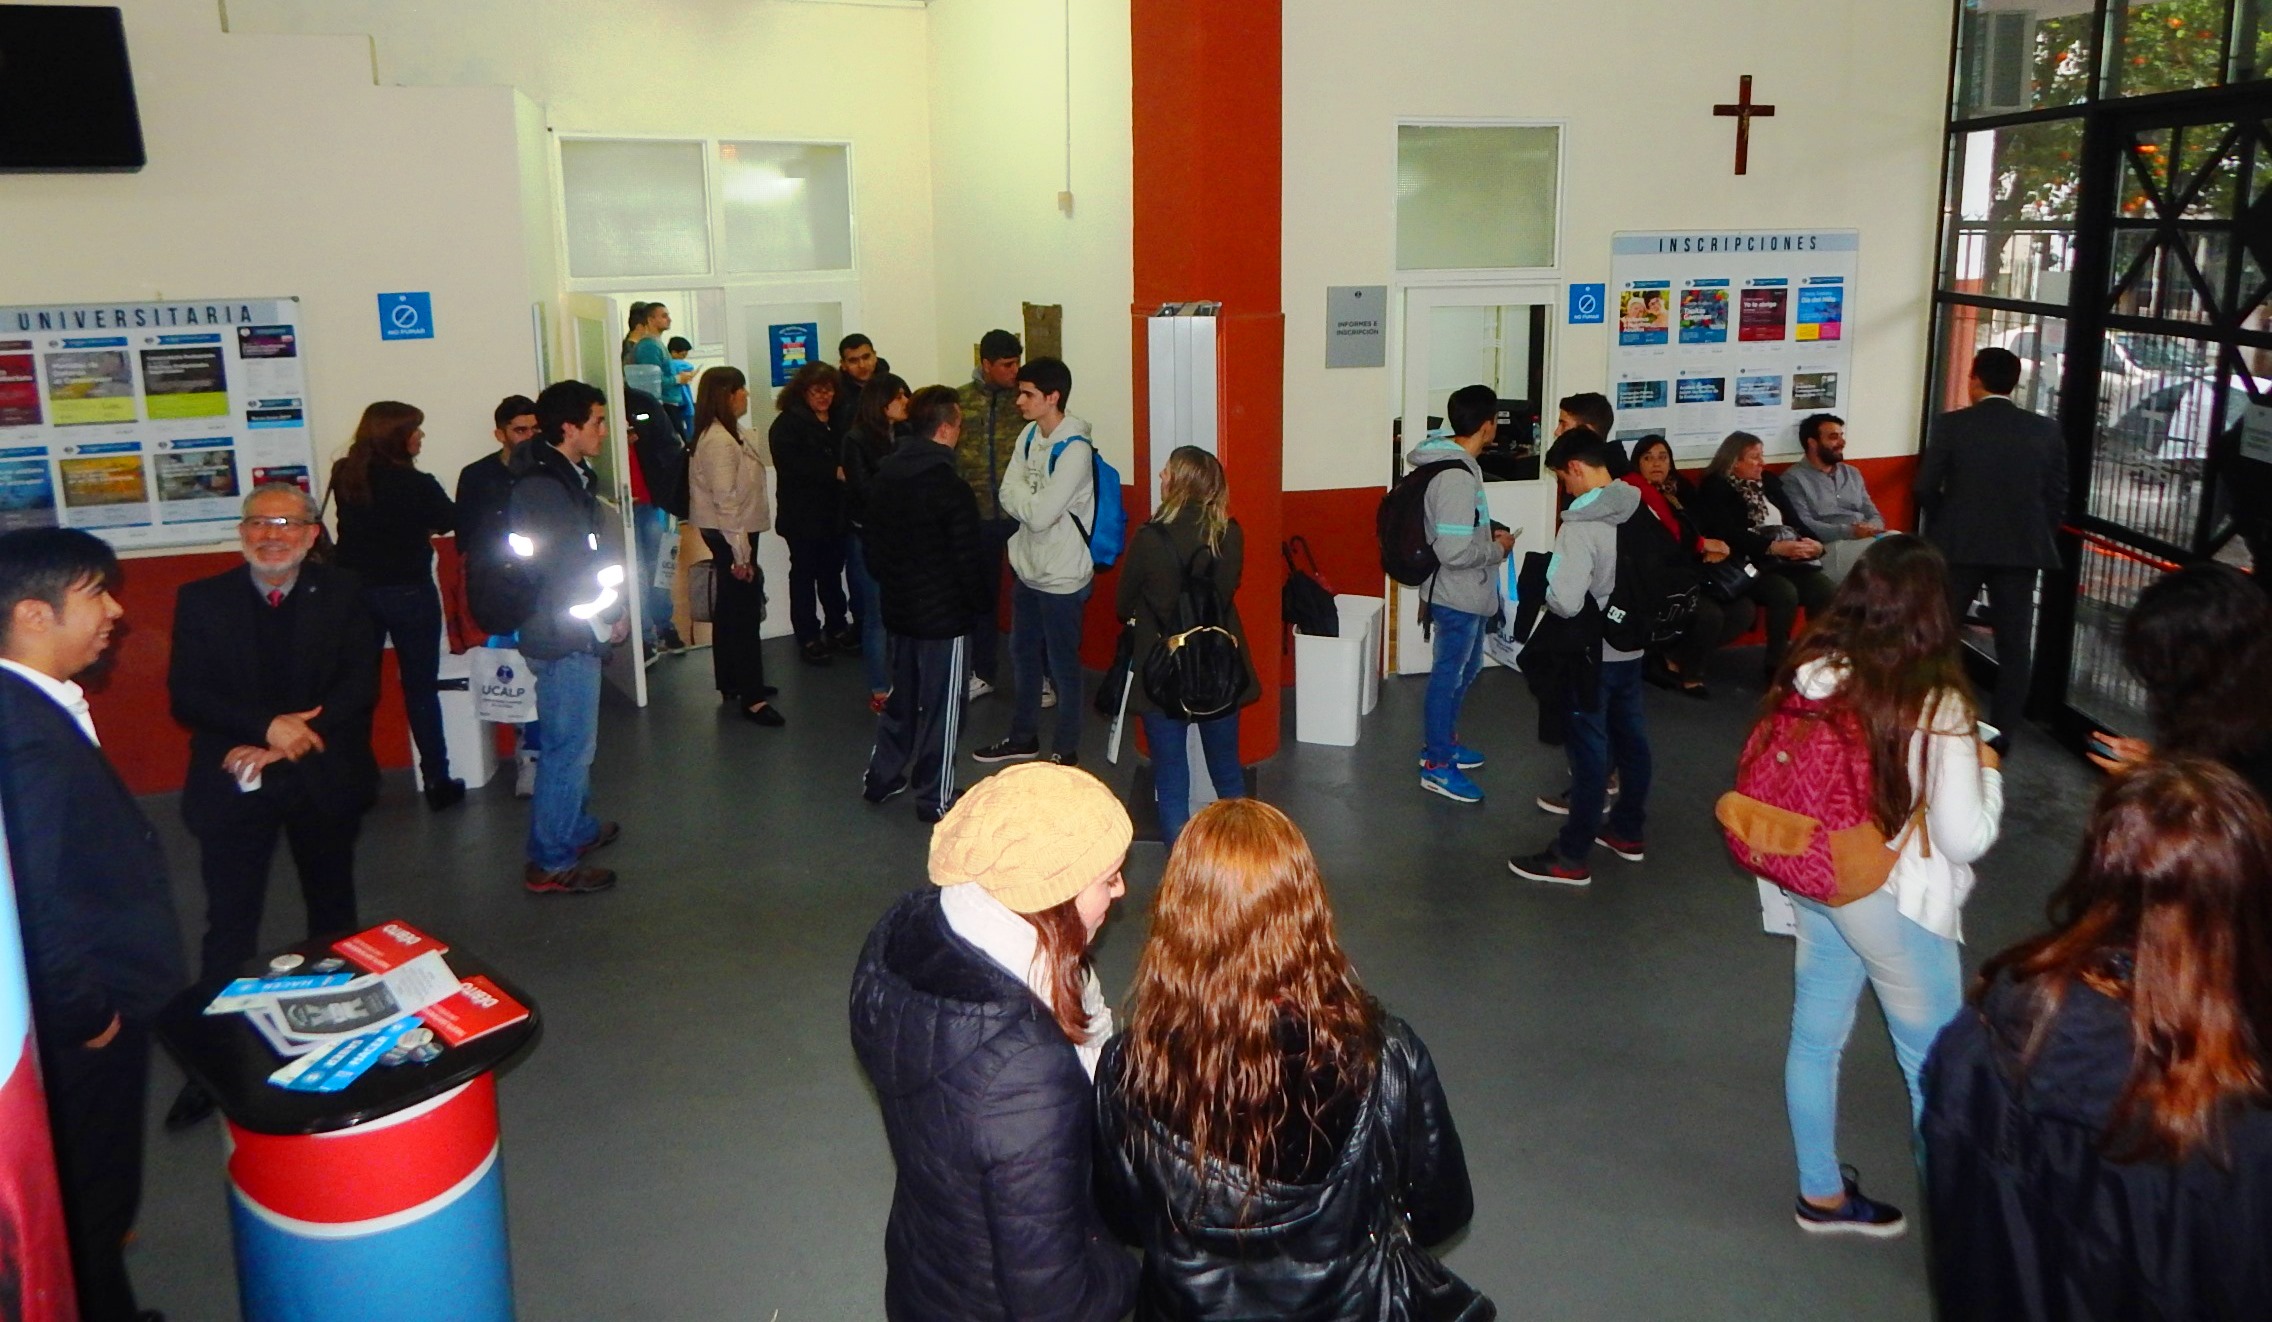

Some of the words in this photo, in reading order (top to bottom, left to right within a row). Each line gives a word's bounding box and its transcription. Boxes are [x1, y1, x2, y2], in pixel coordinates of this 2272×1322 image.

[1659, 235, 1817, 252] INSCRIPCIONES
[18, 305, 252, 330] UNIVERSITARIA
[481, 685, 526, 697] UCALP
